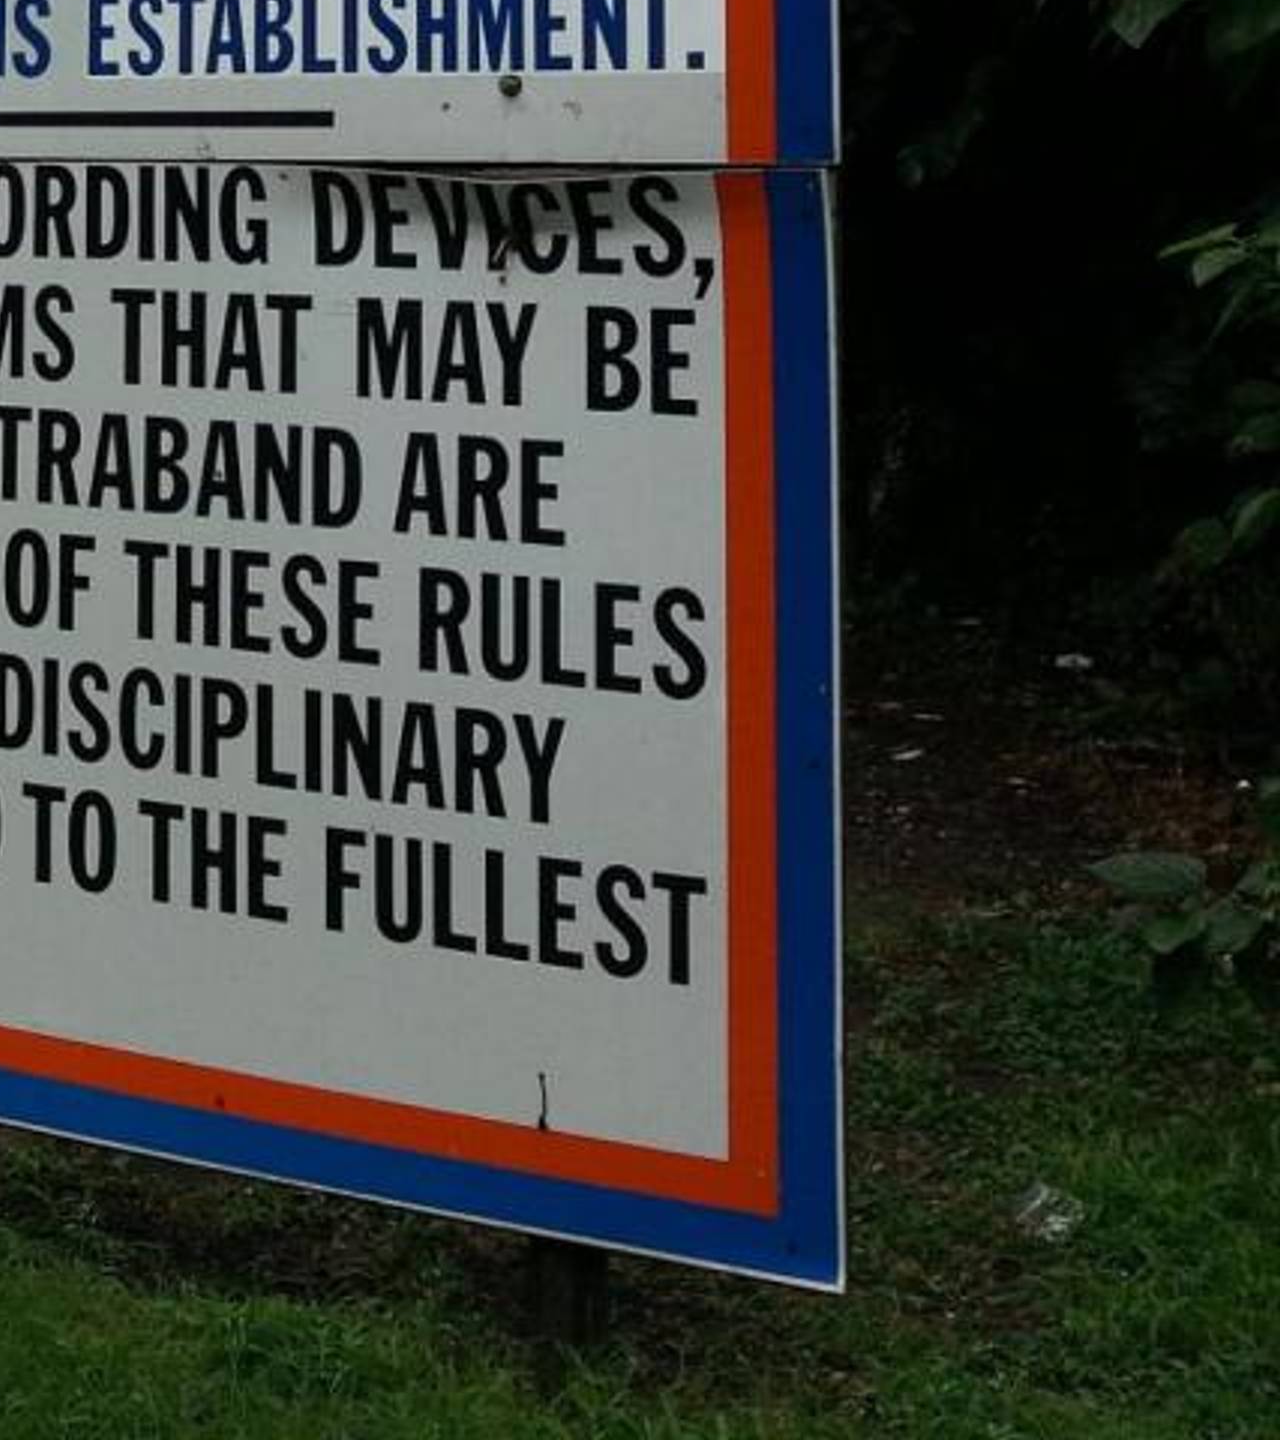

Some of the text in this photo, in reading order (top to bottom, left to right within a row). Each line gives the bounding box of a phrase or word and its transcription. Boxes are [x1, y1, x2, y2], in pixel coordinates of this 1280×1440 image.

[310, 170, 715, 300] DEVICES,
[110, 288, 313, 394] THAT
[356, 297, 538, 406] MAY
[586, 305, 698, 417] BE
[393, 432, 566, 547] ARE
[4, 528, 96, 631] OF
[123, 539, 381, 666] THESE
[419, 567, 707, 700] RULES
[22, 781, 117, 894] TO
[138, 798, 288, 924] THE
[325, 825, 708, 986] FULLEST
